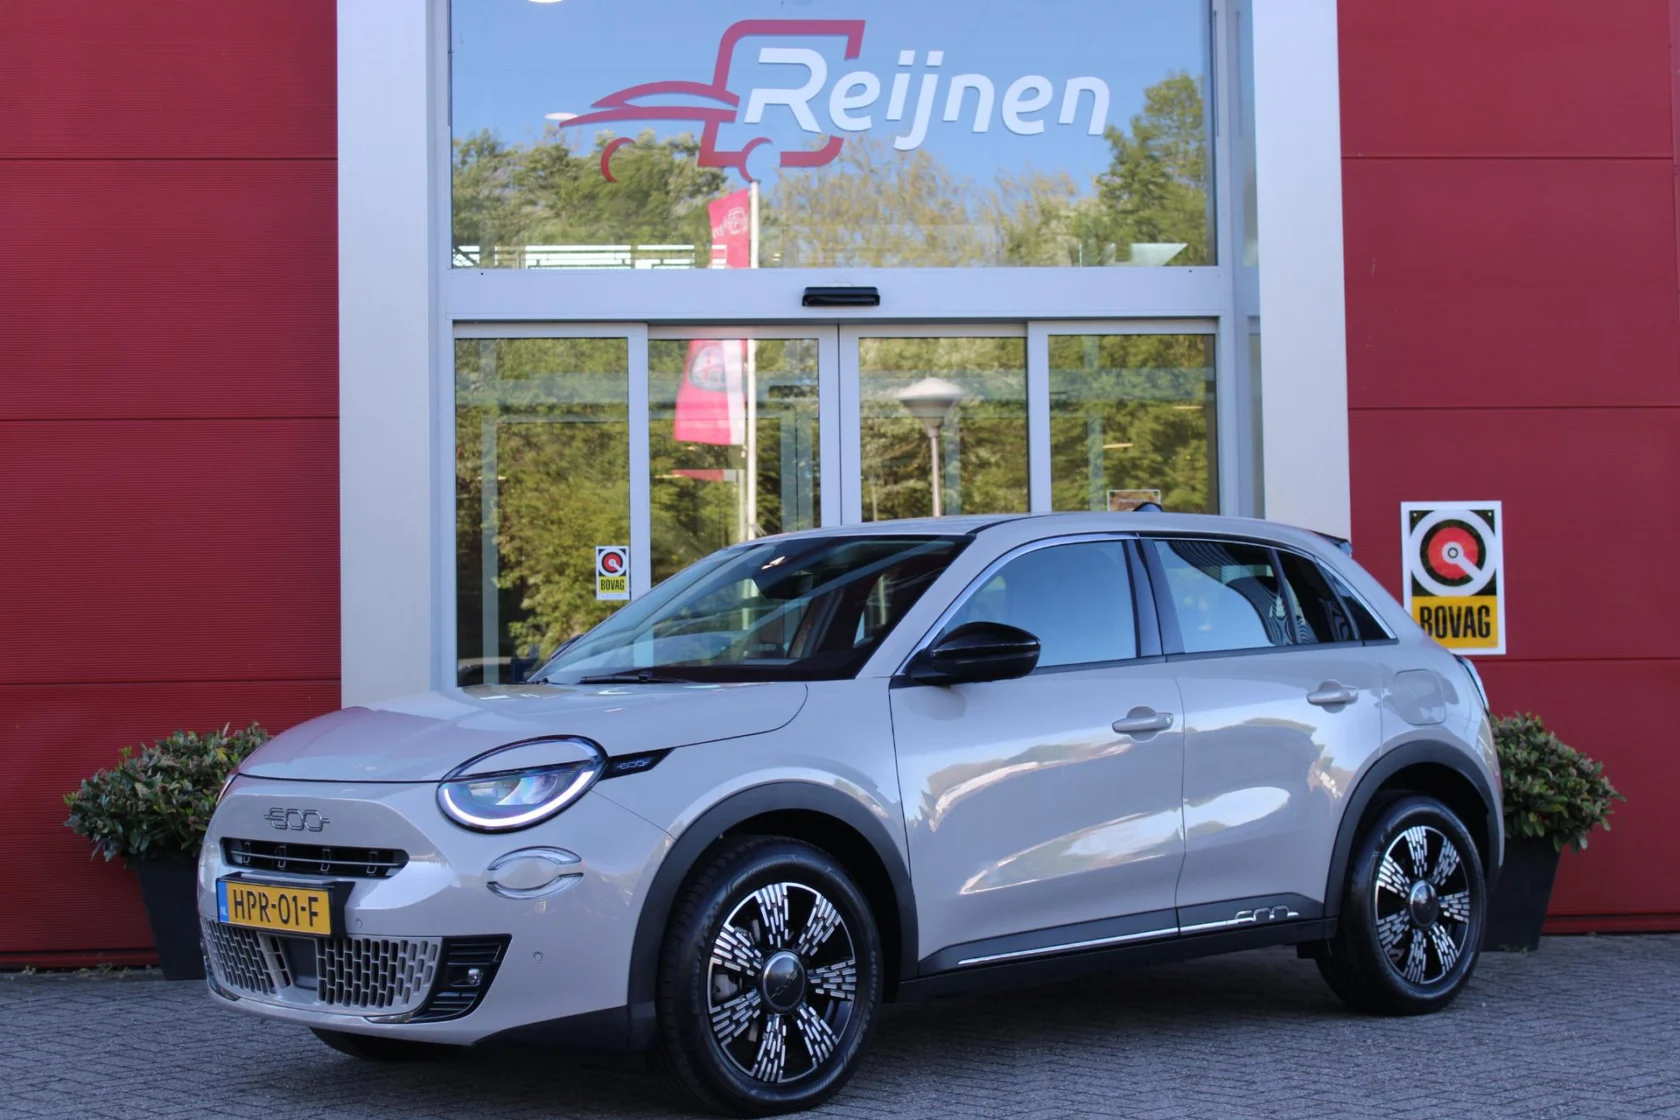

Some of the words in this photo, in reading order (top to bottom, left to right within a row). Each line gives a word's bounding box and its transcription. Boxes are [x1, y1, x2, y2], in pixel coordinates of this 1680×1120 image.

[744, 47, 1111, 151] Reijnen
[600, 579, 625, 591] BOVAG
[1419, 604, 1491, 639] BOVAG
[263, 807, 331, 832] 600
[233, 888, 319, 927] HPR-01-F
